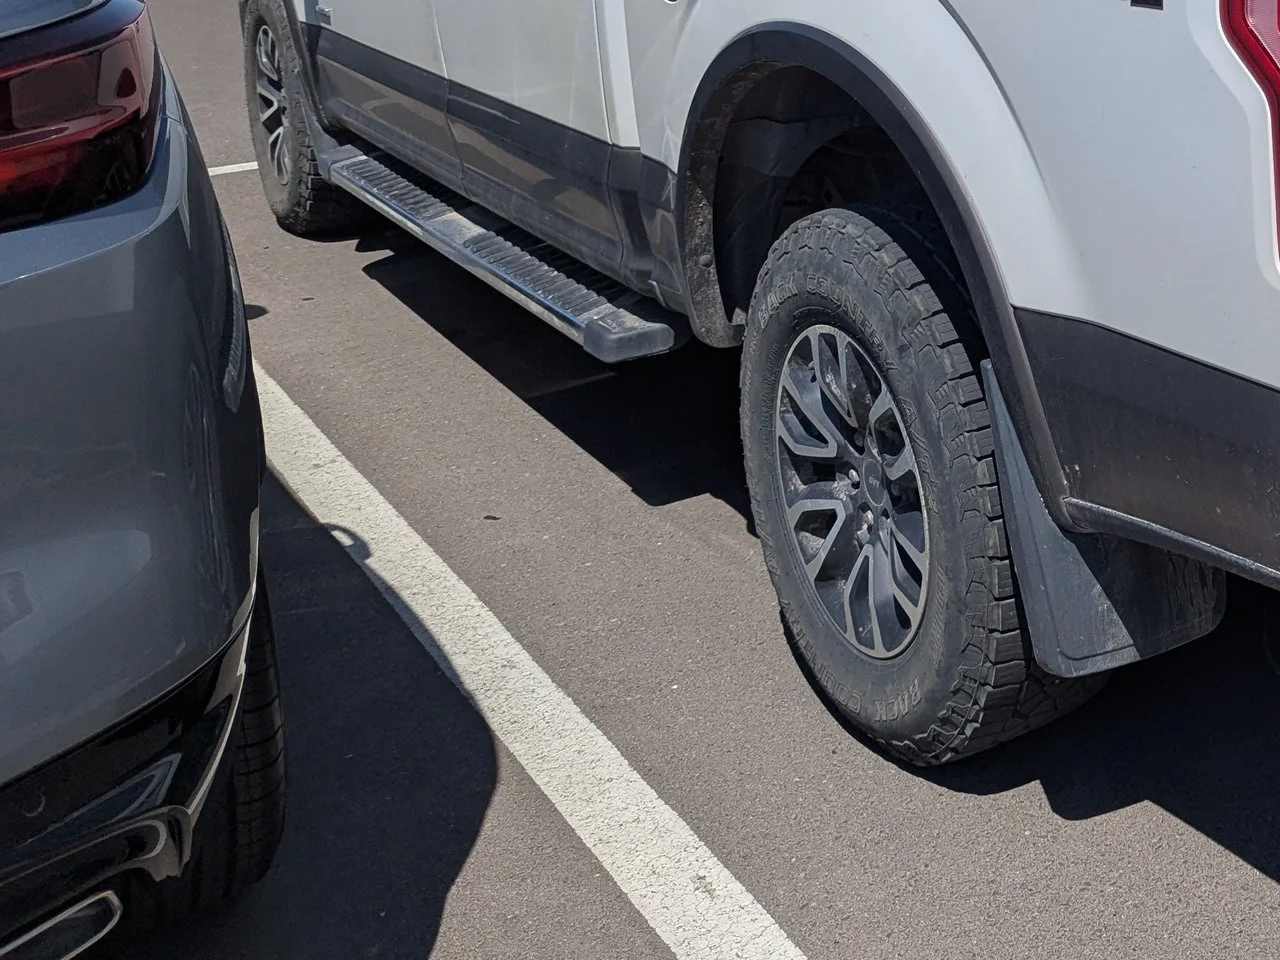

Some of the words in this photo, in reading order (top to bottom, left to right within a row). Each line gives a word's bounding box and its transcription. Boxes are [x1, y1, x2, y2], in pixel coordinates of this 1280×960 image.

[758, 274, 799, 329] BACK
[806, 273, 899, 372] COUNTRY
[874, 677, 922, 722] BACK
